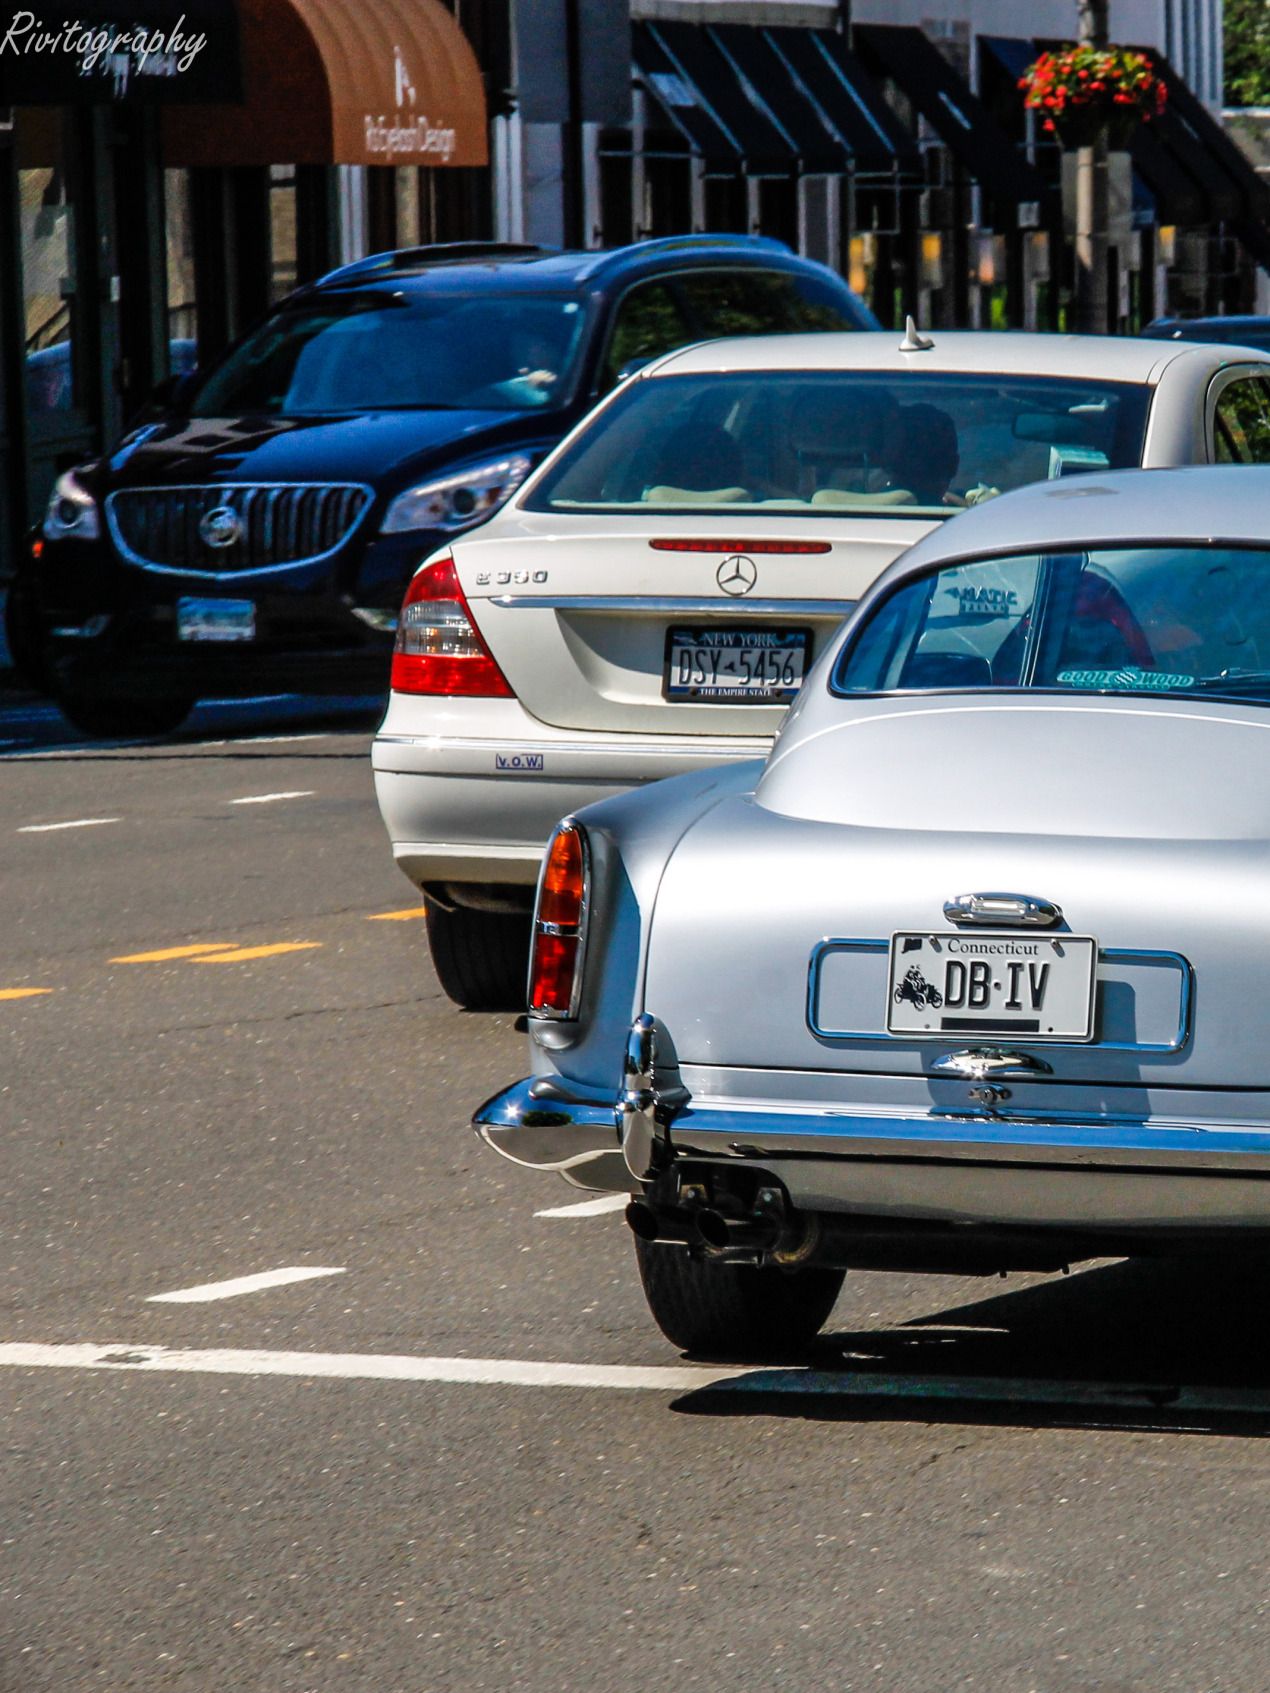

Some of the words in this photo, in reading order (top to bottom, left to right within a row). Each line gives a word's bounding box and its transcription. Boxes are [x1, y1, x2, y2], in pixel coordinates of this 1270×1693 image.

[703, 633, 735, 646] NEW
[739, 634, 776, 647] YORK
[679, 649, 721, 685] DSY
[738, 650, 795, 686] 5456
[700, 688, 716, 696] THE
[718, 688, 747, 697] EMPIRE
[749, 689, 772, 697] STATE
[948, 937, 1039, 956] Connecticut
